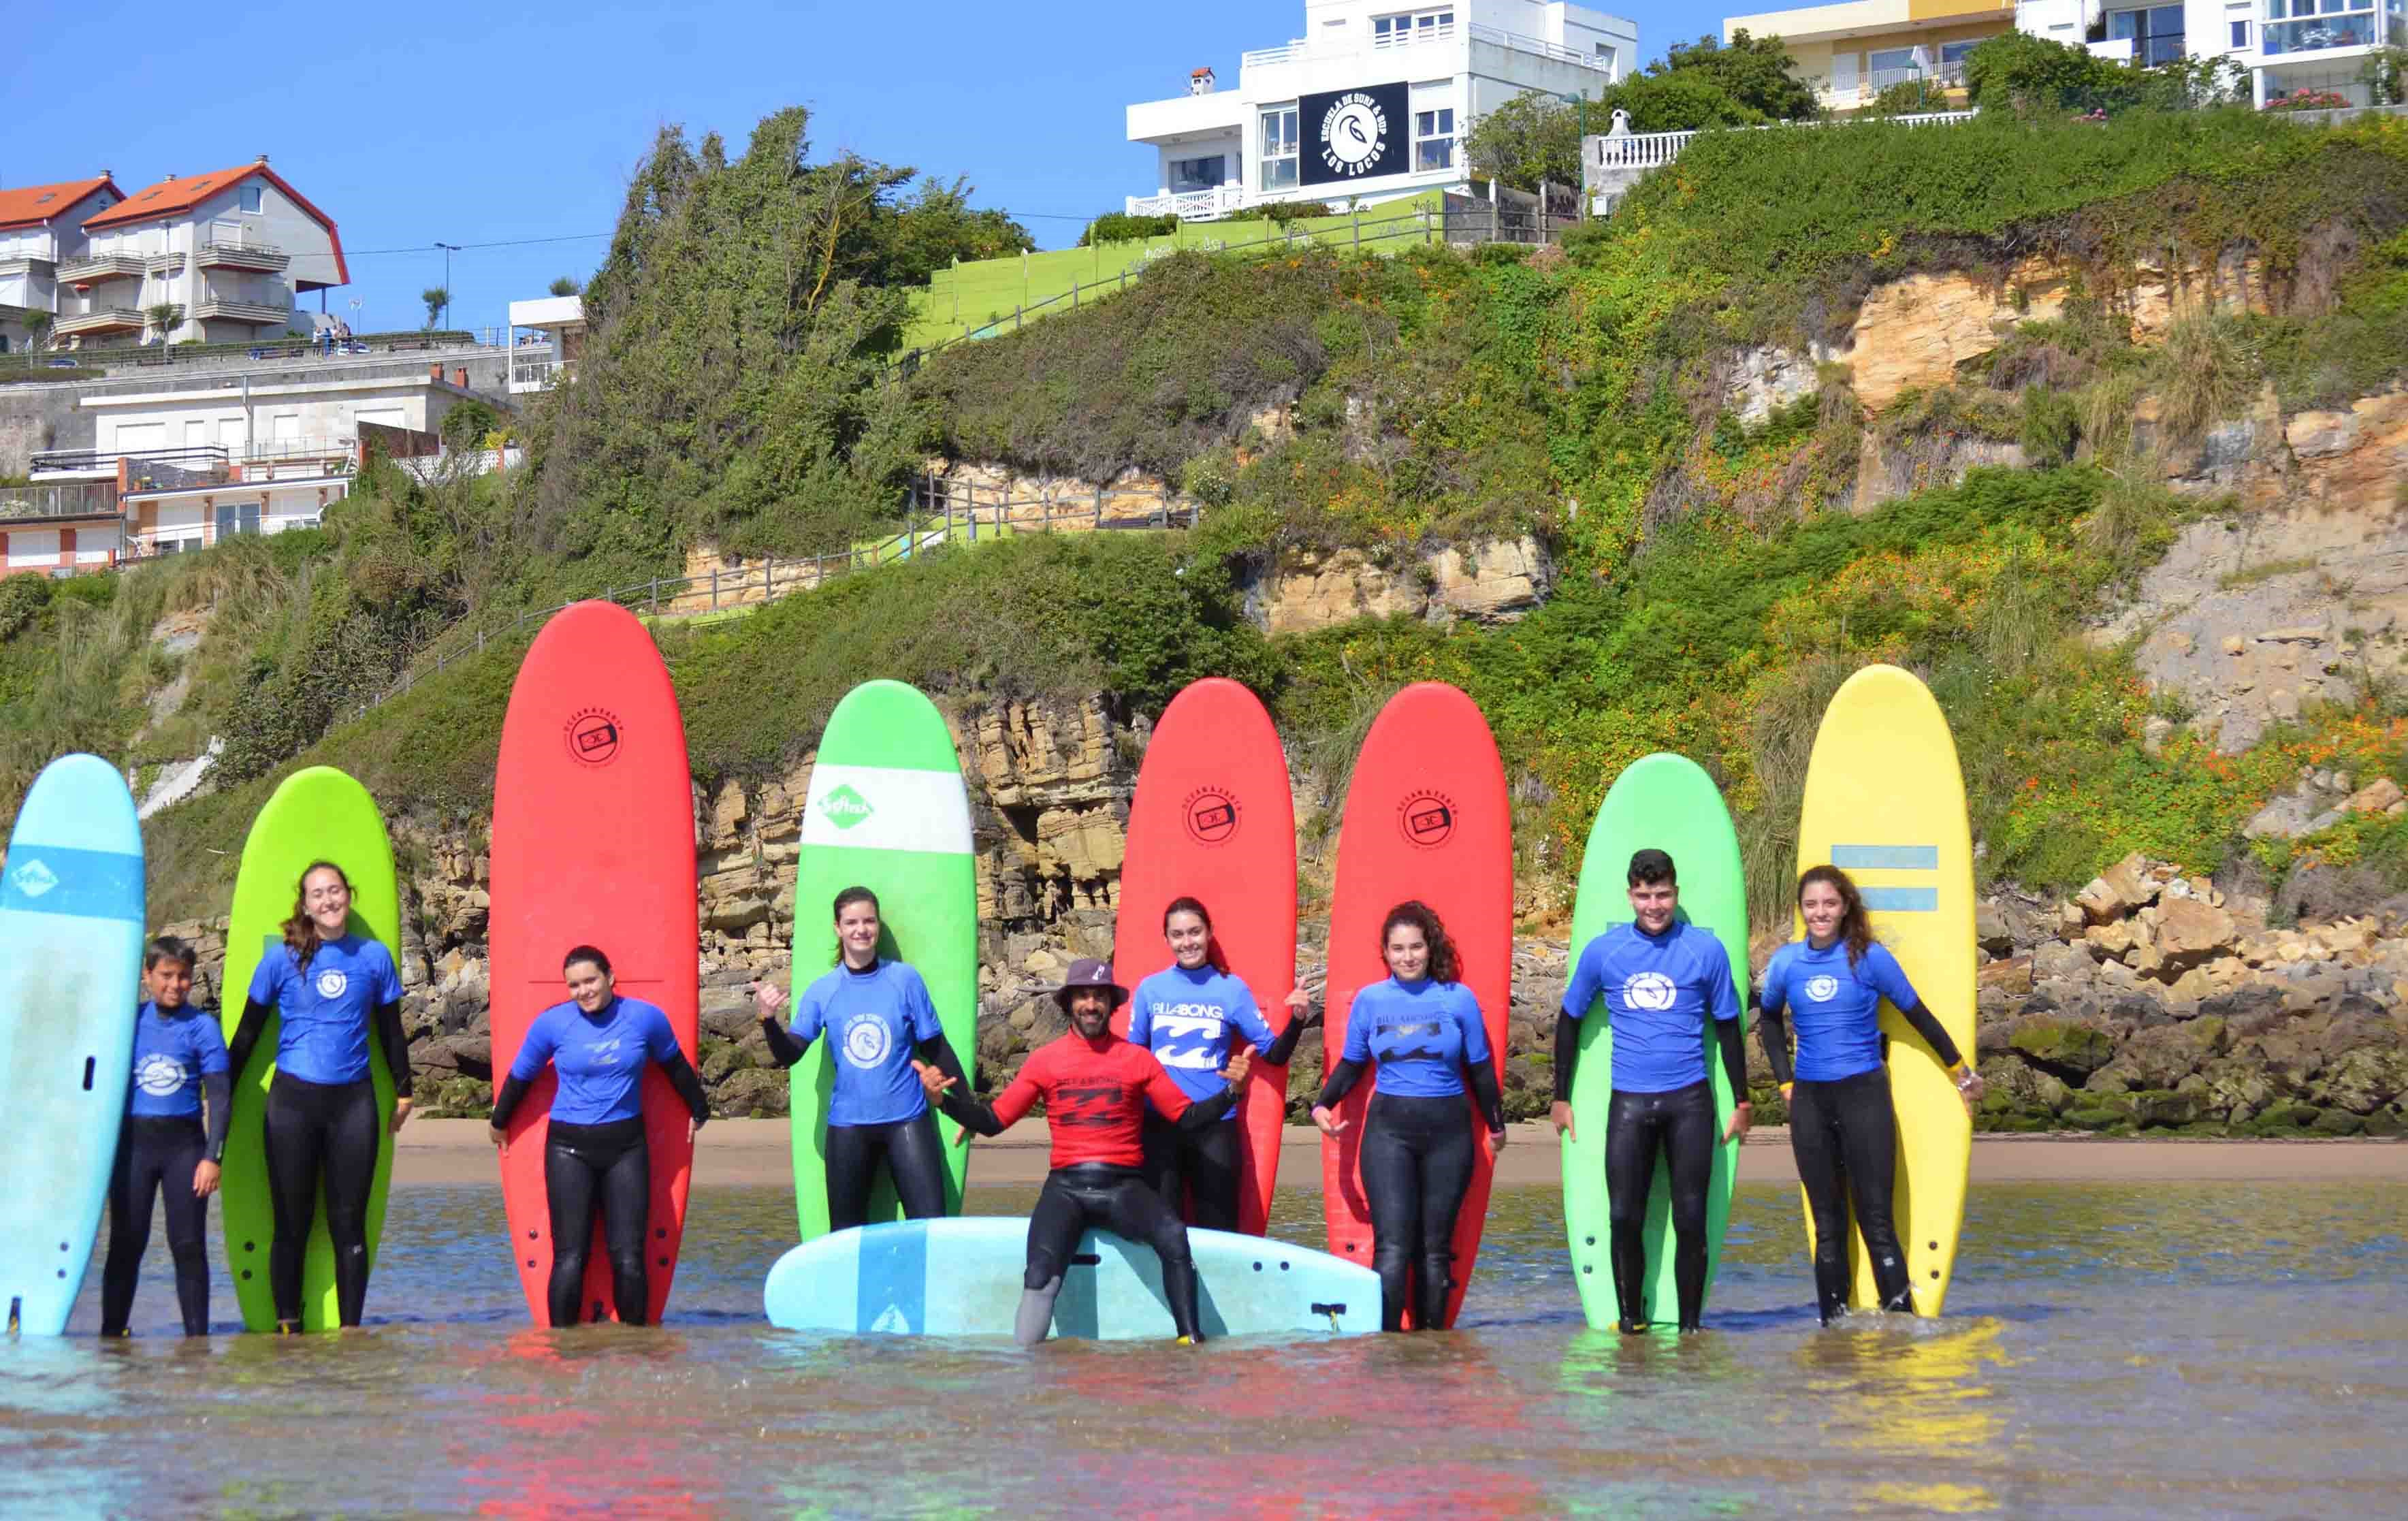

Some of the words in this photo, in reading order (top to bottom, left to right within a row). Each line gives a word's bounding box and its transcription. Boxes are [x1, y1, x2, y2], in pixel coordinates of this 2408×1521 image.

[1342, 94, 1353, 106] DE
[1353, 93, 1375, 108] SURF
[1372, 105, 1381, 115] &
[1321, 100, 1343, 142] ESCUELA
[1376, 114, 1387, 135] SUP
[1321, 148, 1344, 173] LOS
[1348, 142, 1386, 176] LOCOS
